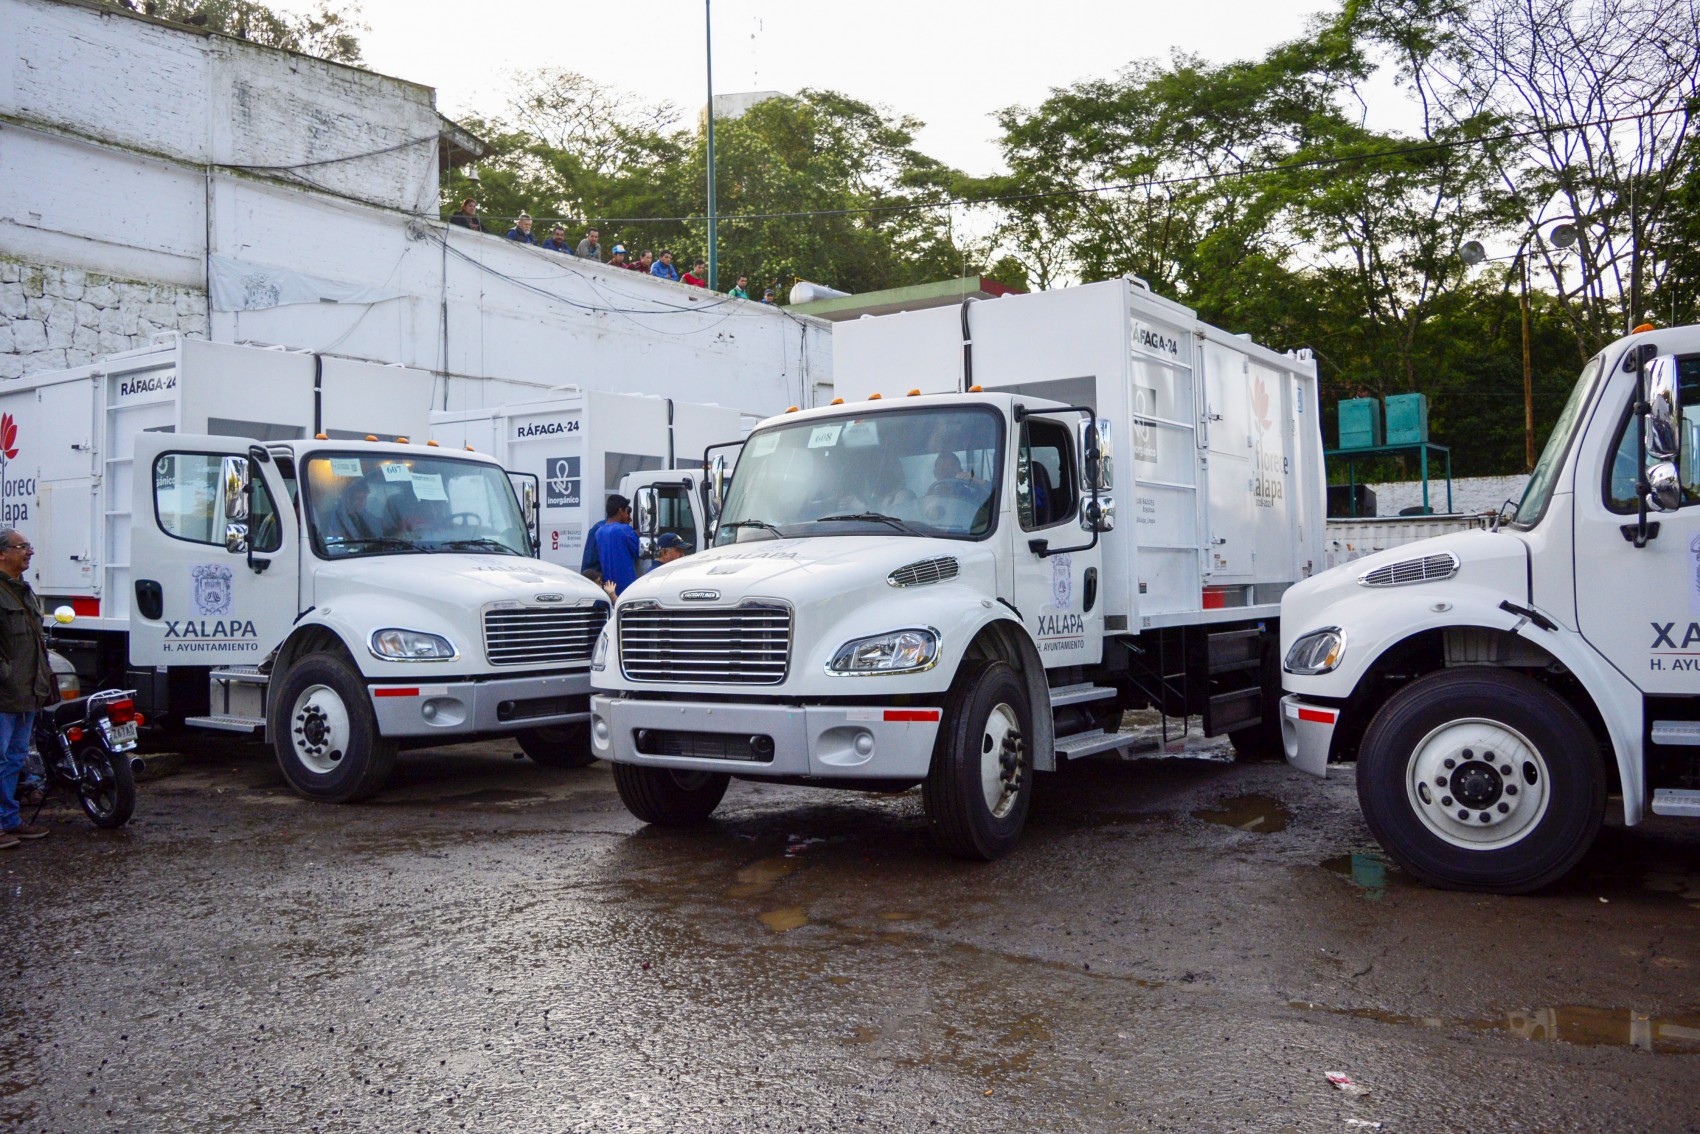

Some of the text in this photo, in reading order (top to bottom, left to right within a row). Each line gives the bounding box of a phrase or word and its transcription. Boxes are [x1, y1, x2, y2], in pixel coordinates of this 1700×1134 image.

[1132, 321, 1178, 356] ÁFAGA-24
[121, 376, 176, 396] RÁFAGA-24
[517, 420, 580, 437] RÁFAGA-24
[386, 465, 402, 474] 607
[0, 468, 36, 498] lorec
[1252, 471, 1283, 507] alapa
[547, 496, 580, 506] inorgánico
[0, 498, 29, 529] lapa
[163, 620, 258, 638] XALAPA
[1037, 614, 1084, 636] XALAPA
[163, 643, 259, 652] H. AYUNTAMIENTO
[1037, 640, 1085, 652] H. AYUNTAMIENTO
[1650, 658, 1666, 671] H.
